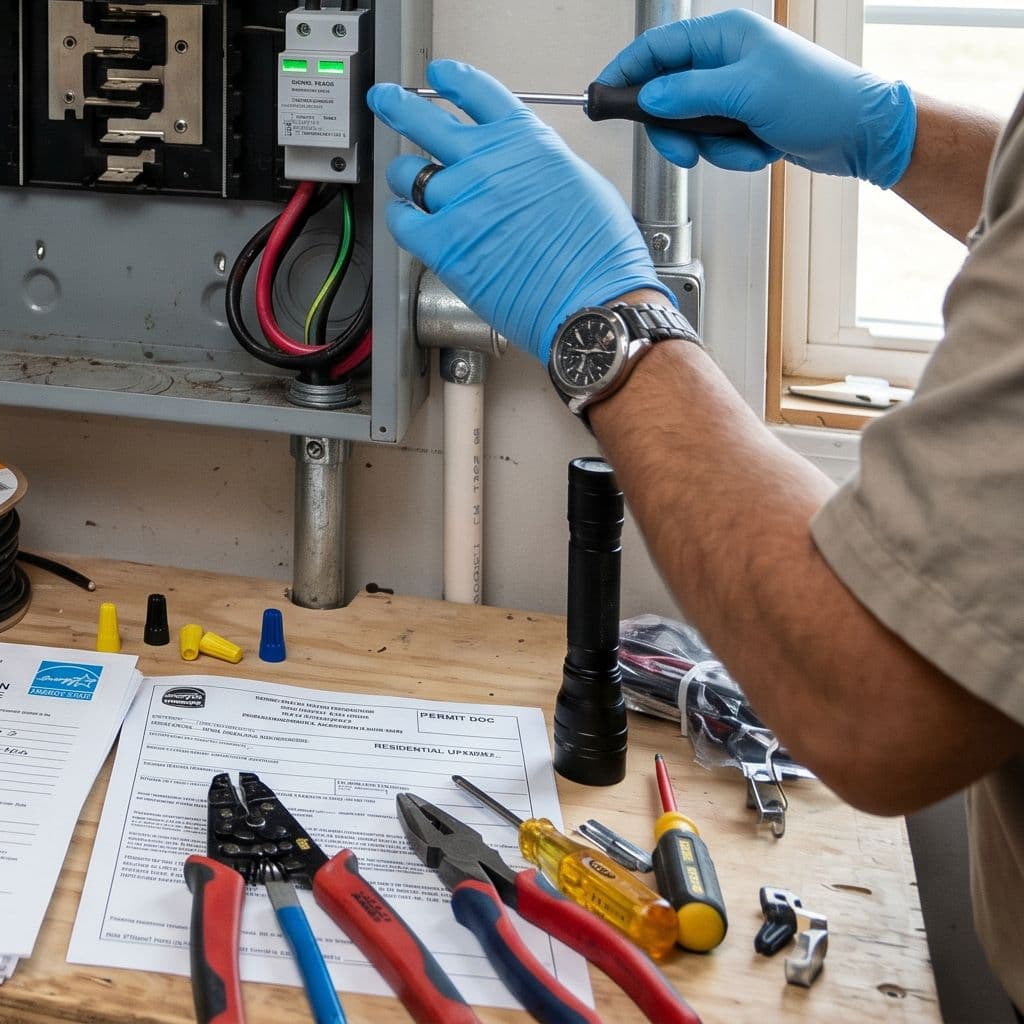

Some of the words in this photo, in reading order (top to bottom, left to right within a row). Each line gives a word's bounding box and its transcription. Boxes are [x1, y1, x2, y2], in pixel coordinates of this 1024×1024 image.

[419, 711, 466, 721] PERMIT
[469, 716, 495, 724] DOC
[373, 742, 444, 754] RESIDENTIAL
